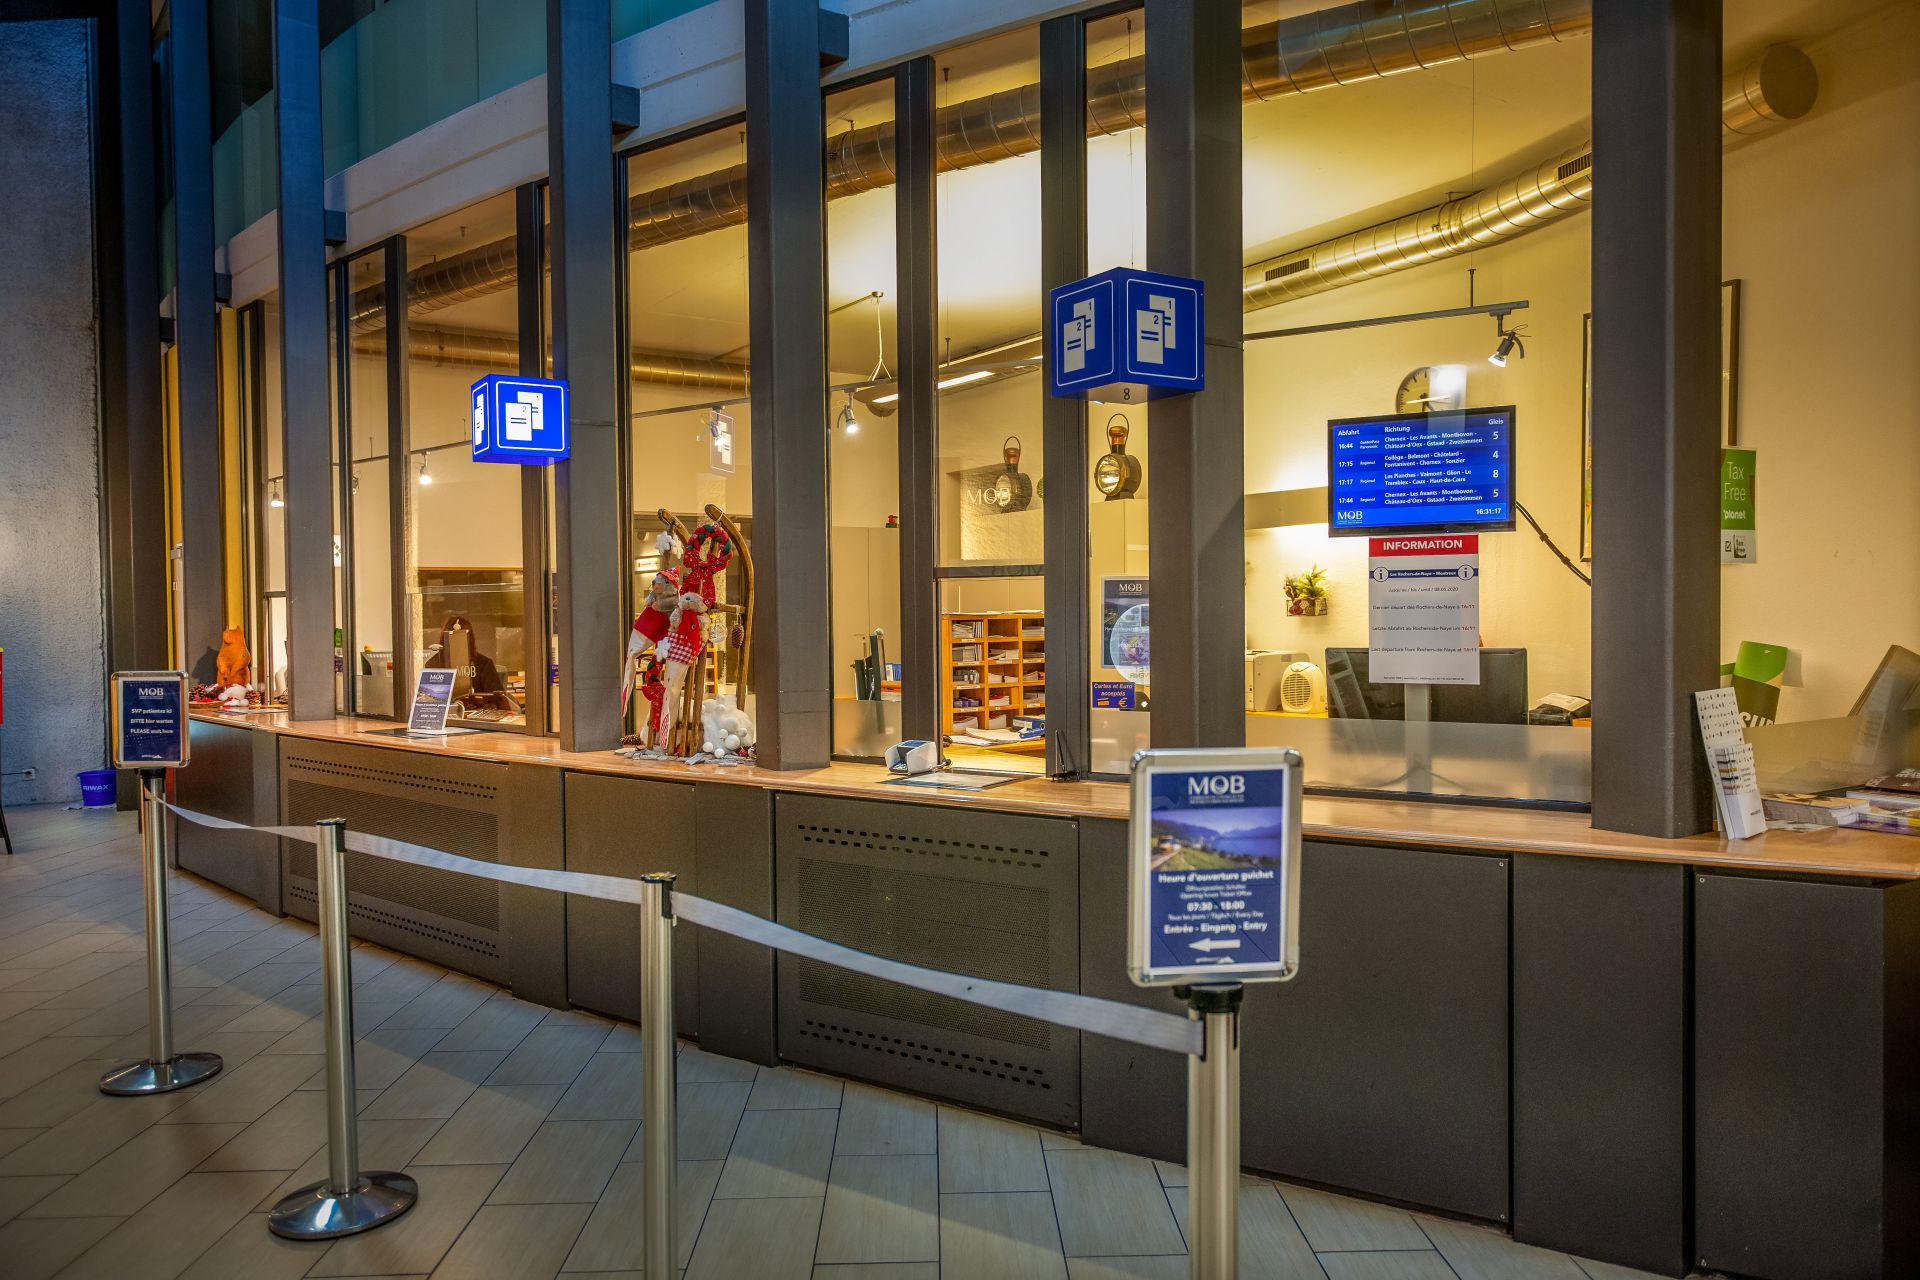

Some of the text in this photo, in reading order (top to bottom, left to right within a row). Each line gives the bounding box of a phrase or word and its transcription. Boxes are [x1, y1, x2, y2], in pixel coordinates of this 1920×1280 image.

[1089, 302, 1091, 310] 1
[1168, 300, 1172, 309] 1
[1154, 315, 1158, 324] 2
[1077, 322, 1081, 331] 2
[1124, 388, 1130, 400] 8
[1493, 431, 1499, 440] 5
[1493, 450, 1499, 459] 4
[1493, 470, 1498, 478] 8
[1727, 462, 1744, 480] Tax
[1493, 489, 1499, 497] 5
[1725, 483, 1746, 500] Free
[967, 488, 1011, 505] MOB
[1337, 511, 1363, 520] MOB
[1383, 540, 1463, 550] INFORMATION
[1188, 775, 1245, 795] MOB
[1158, 870, 1274, 883] Heure d'ouverture guichet
[1164, 924, 1194, 934] Entrée
[1200, 922, 1236, 933] Eingang
[1243, 921, 1267, 932] Entry
